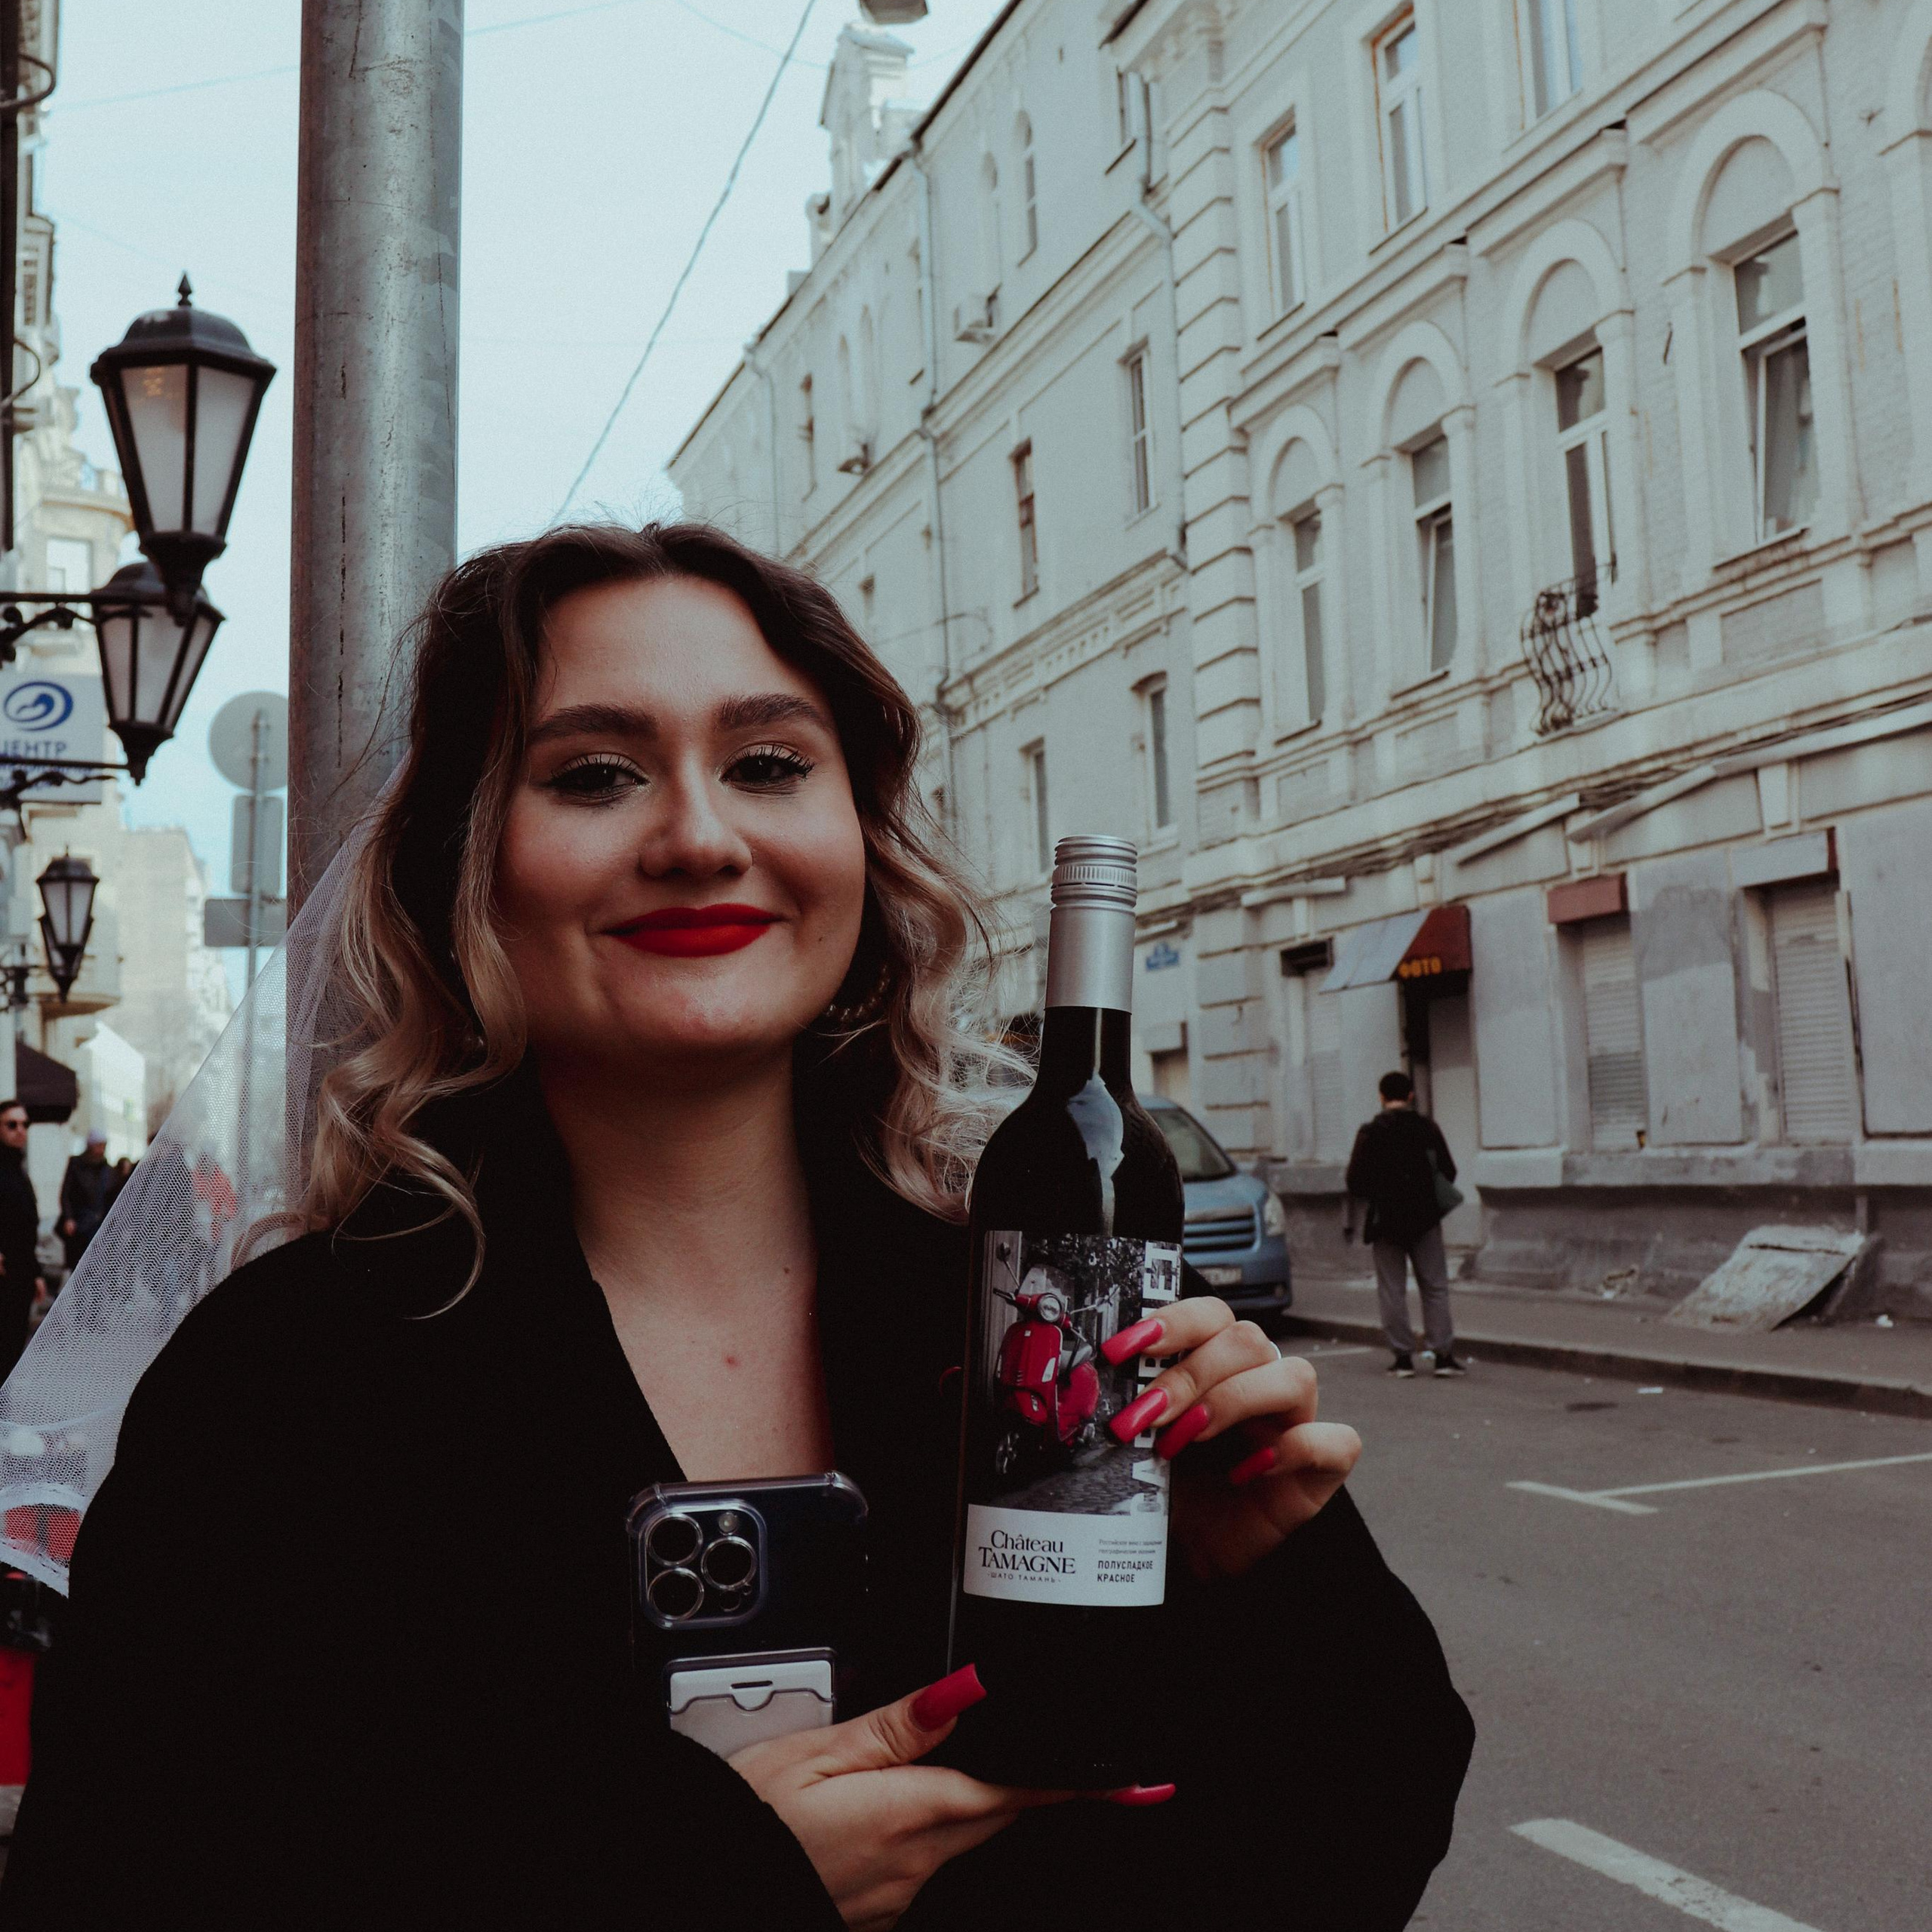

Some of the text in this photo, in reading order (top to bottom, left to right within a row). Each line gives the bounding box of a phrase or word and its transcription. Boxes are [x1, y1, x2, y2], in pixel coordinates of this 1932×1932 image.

[991, 1529, 1064, 1553] Château
[979, 1547, 1076, 1574] TAMAGNE
[1098, 1560, 1153, 1571] ПОЛУСЛАДКОЕ
[1097, 1574, 1135, 1583] КРАСНОЕ
